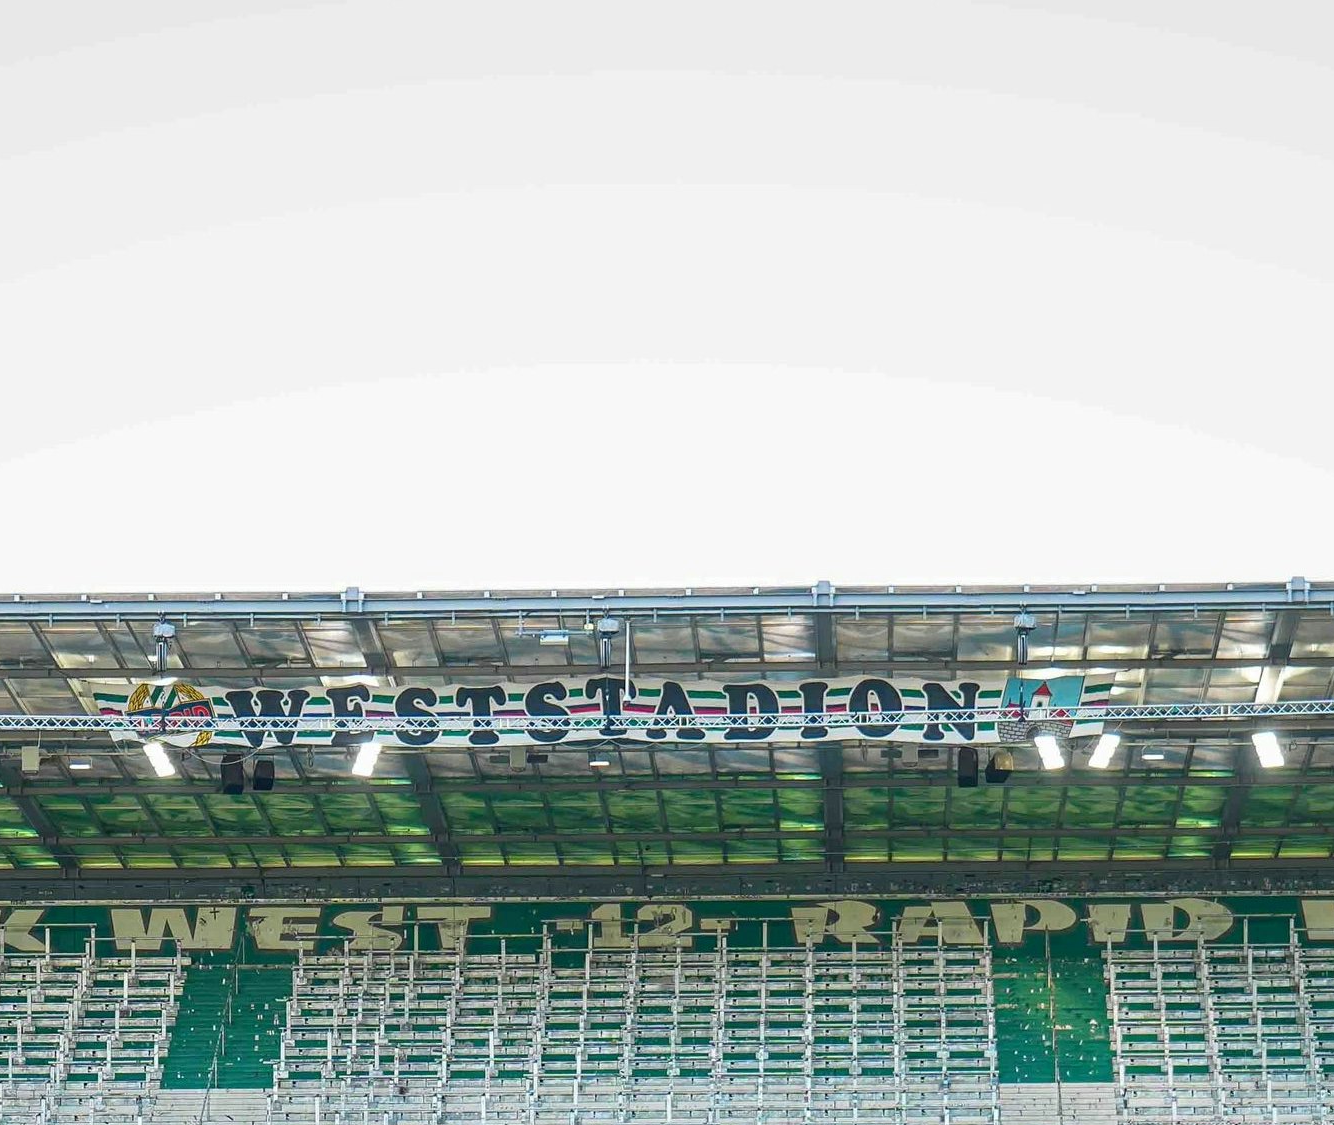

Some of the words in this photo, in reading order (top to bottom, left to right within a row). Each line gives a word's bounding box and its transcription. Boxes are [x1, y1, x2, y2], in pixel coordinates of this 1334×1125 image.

[225, 677, 981, 748] WESTSTADION
[109, 904, 493, 951] WEST
[790, 898, 1234, 943] RAPID
